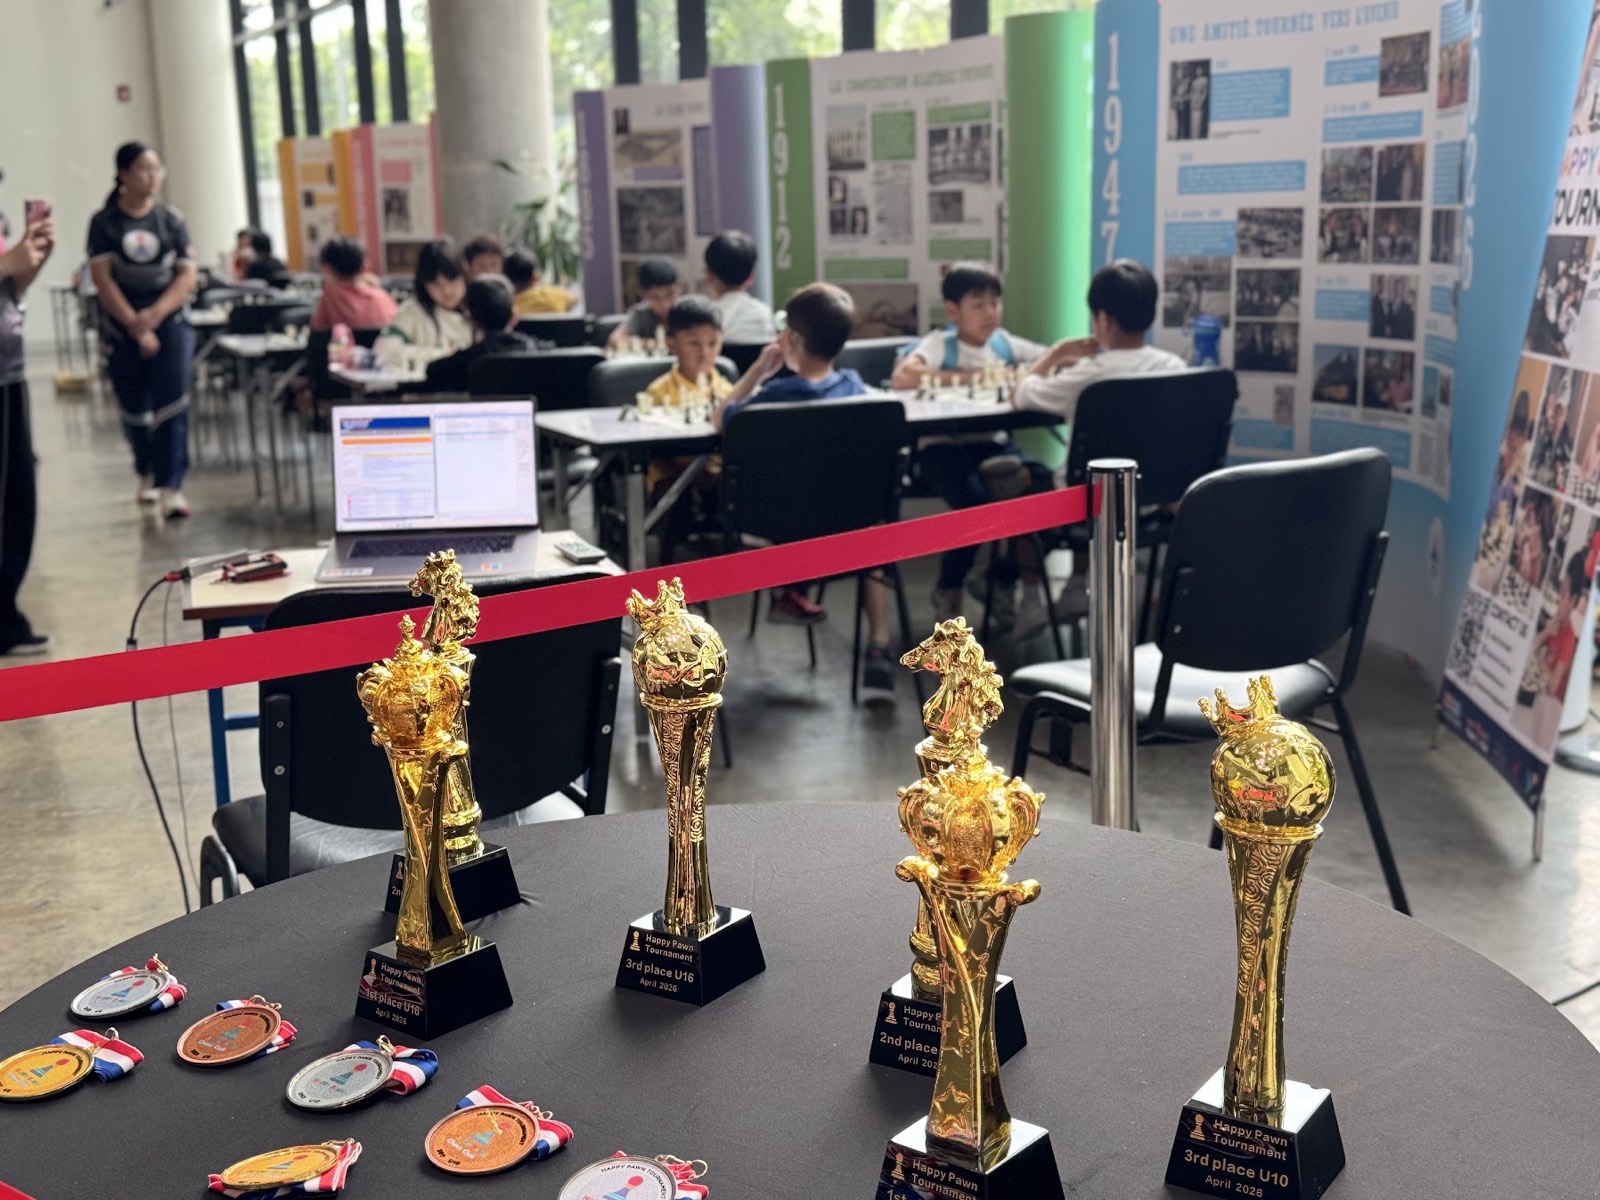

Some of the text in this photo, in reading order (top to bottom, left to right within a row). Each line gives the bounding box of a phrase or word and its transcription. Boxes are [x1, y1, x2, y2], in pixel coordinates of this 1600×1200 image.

[1101, 31, 1123, 266] 1947
[773, 82, 792, 269] 1912
[391, 885, 401, 896] 2n
[645, 933, 694, 951] Happy Pawn
[645, 944, 693, 963] Tournament
[380, 962, 423, 984] Happy Pawn
[625, 958, 695, 983] 3rd place U16
[380, 973, 420, 995] Tournament
[639, 977, 678, 993] April 2026
[366, 988, 421, 1016] 1st place U16
[375, 1008, 390, 1019] April
[903, 1005, 934, 1021] Happy
[880, 1032, 938, 1055] 2nd place
[897, 1053, 938, 1070] April 202
[1212, 1119, 1288, 1147] Happy Pawn
[1213, 1132, 1287, 1160] Tournament
[601, 1164, 625, 1173] HAPPY
[912, 1159, 978, 1192] Happy Pawn
[1184, 1149, 1289, 1188] 3rd place U10
[911, 1173, 977, 1200] Tournament
[1205, 1174, 1263, 1198] April 2026
